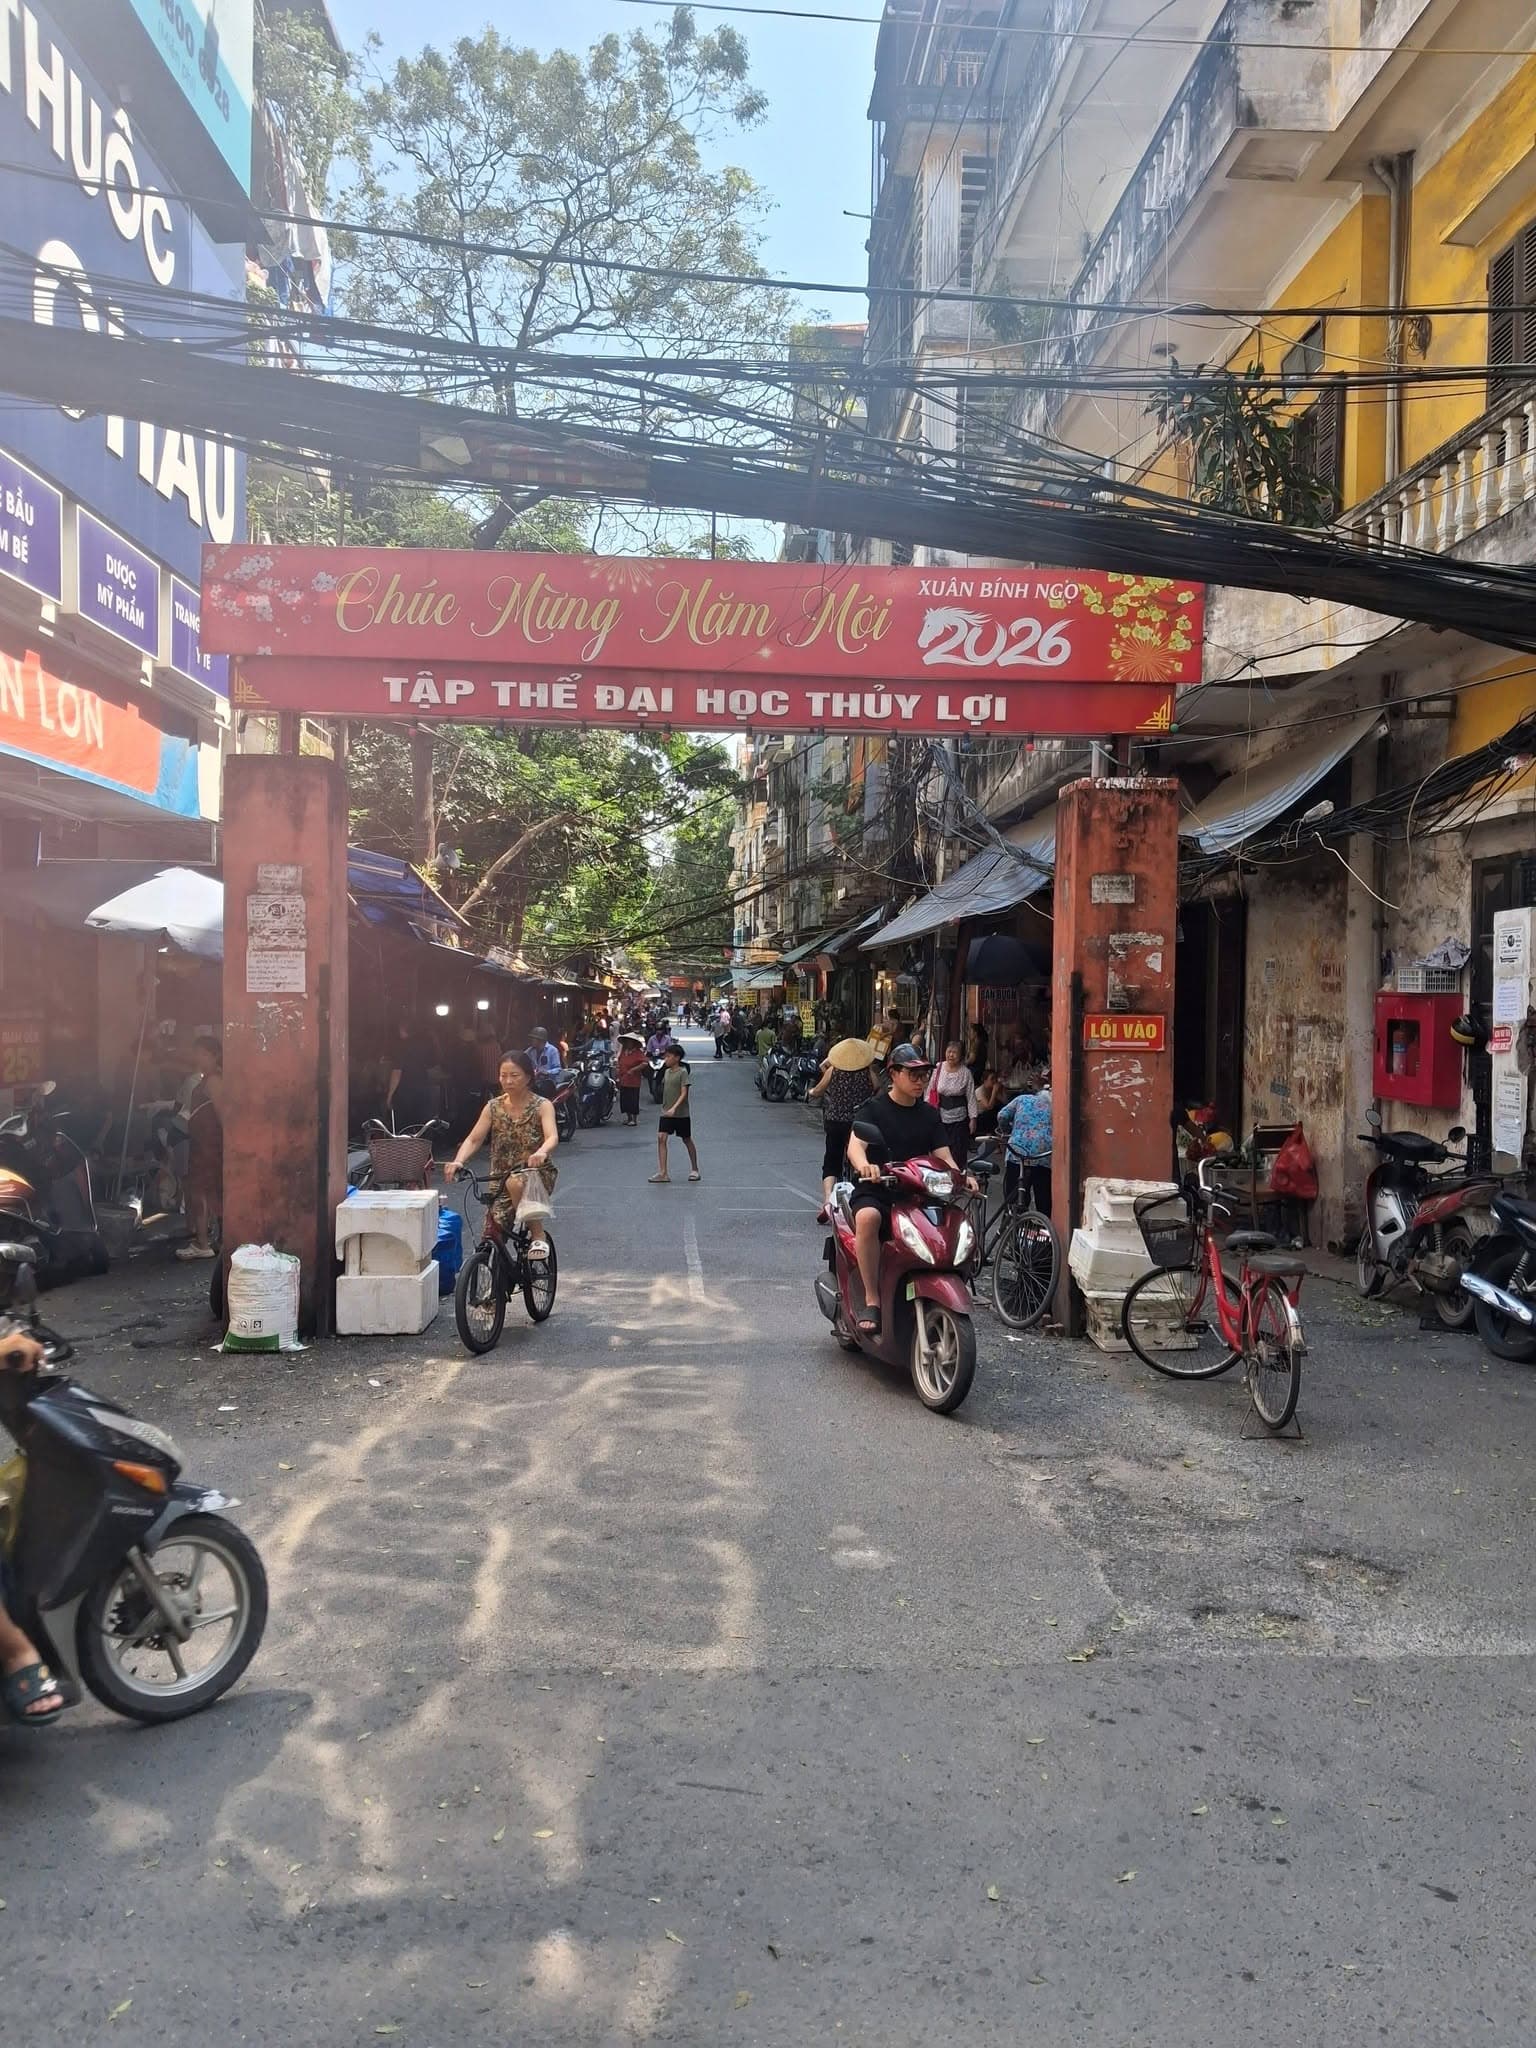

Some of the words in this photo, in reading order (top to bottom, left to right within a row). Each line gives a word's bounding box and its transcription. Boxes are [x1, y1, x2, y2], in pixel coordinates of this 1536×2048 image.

[12, 535, 28, 564] BÉ
[105, 553, 137, 590] DƯỢC
[918, 579, 975, 598] XUÂN
[979, 576, 1029, 599] BÍNH
[1034, 583, 1079, 605] NGỌ
[335, 566, 461, 633] Chúc
[470, 572, 624, 662] Mừng
[639, 578, 777, 645] Năm
[786, 583, 893, 654] Mới
[920, 608, 1076, 667] 2026
[382, 670, 475, 709] TẬP
[491, 672, 582, 710] THỂ
[594, 684, 673, 717] ĐẠI
[696, 688, 789, 720] HỌC
[805, 683, 922, 720] THỦY
[937, 693, 1007, 726] LỢI
[1090, 1017, 1117, 1039] LỐI
[1122, 1020, 1157, 1039] VÀO
